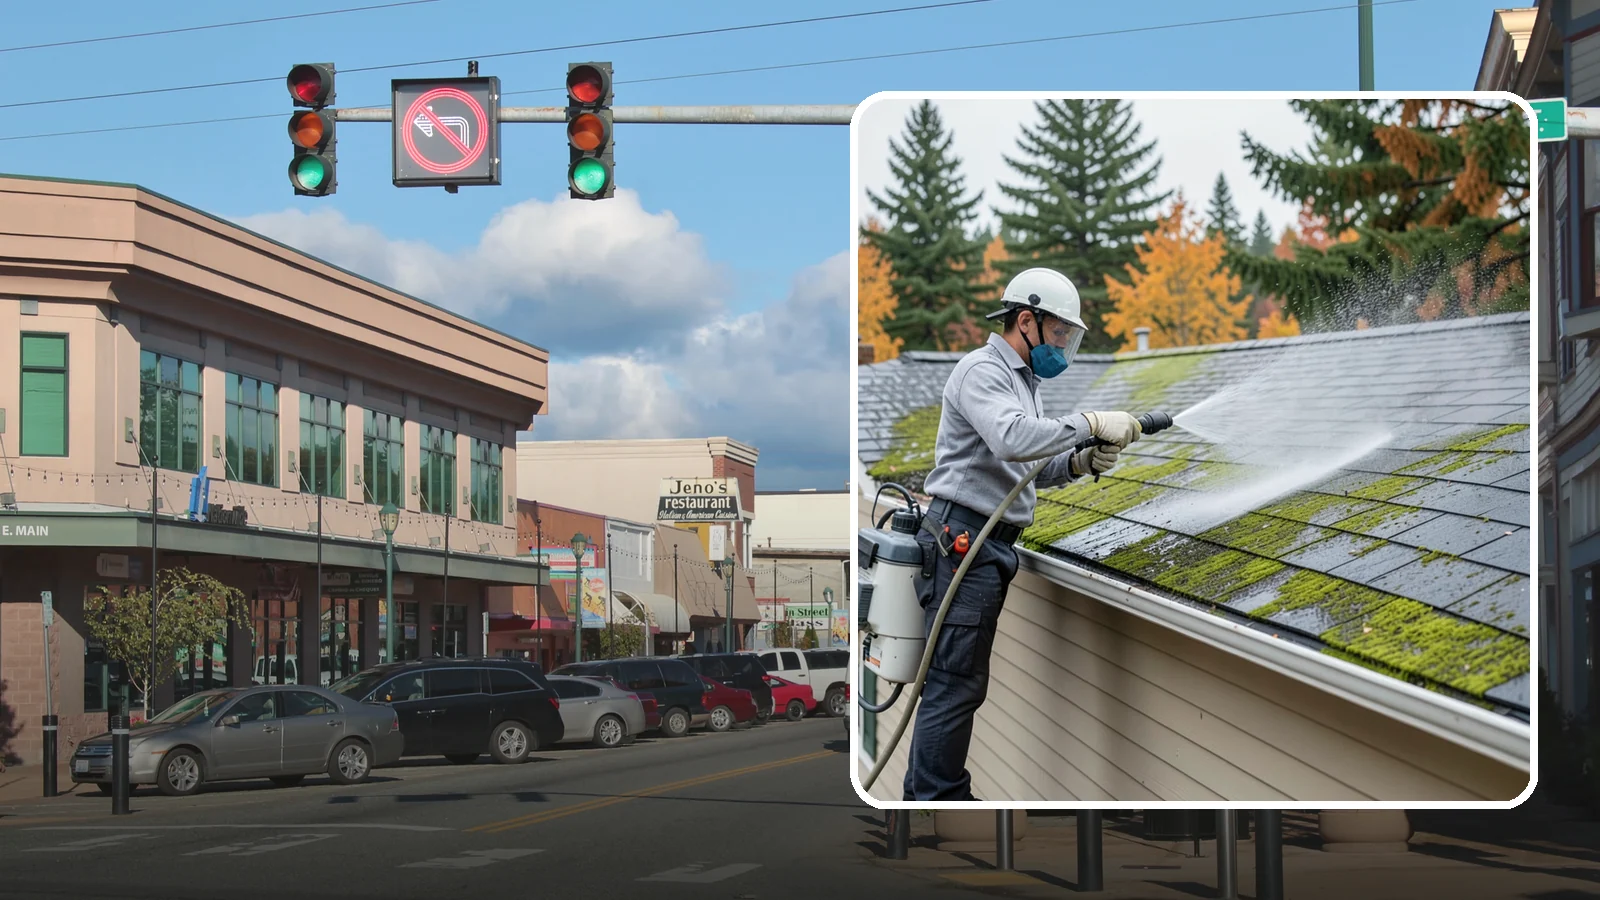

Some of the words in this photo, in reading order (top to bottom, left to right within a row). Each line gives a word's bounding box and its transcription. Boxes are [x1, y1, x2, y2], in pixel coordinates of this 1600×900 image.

[669, 480, 728, 495] Jeno's
[665, 496, 731, 509] restaurant
[686, 509, 714, 519] American
[715, 509, 738, 519] Cuisine
[2, 525, 13, 536] E.
[15, 525, 49, 536] MAIN
[797, 607, 829, 617] Street
[790, 619, 824, 627] lass
